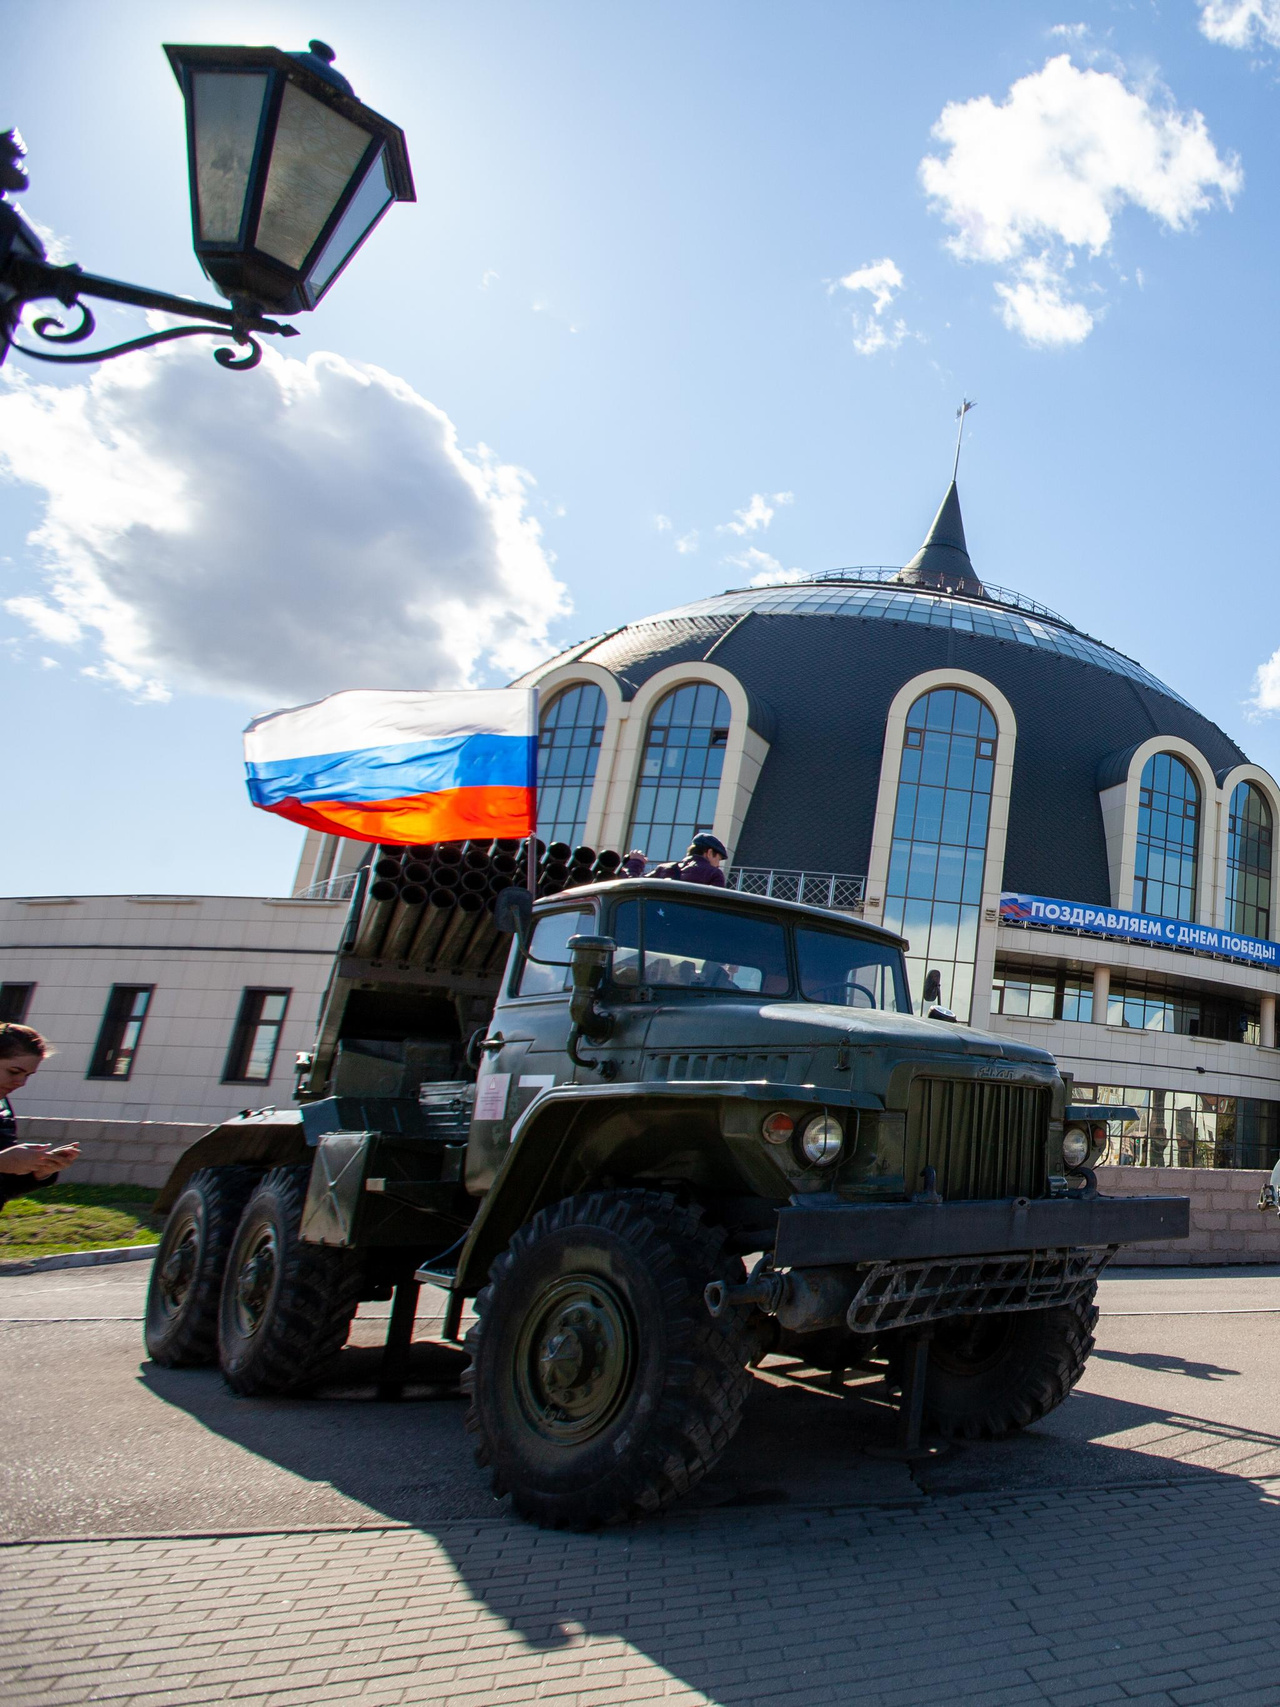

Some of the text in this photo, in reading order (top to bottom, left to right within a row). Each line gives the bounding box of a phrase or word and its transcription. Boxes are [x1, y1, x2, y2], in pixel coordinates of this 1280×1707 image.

[1031, 901, 1276, 960] ПОЗДРАВЛЯЕМ С ДНЕМ ПОБЕДЫ!
